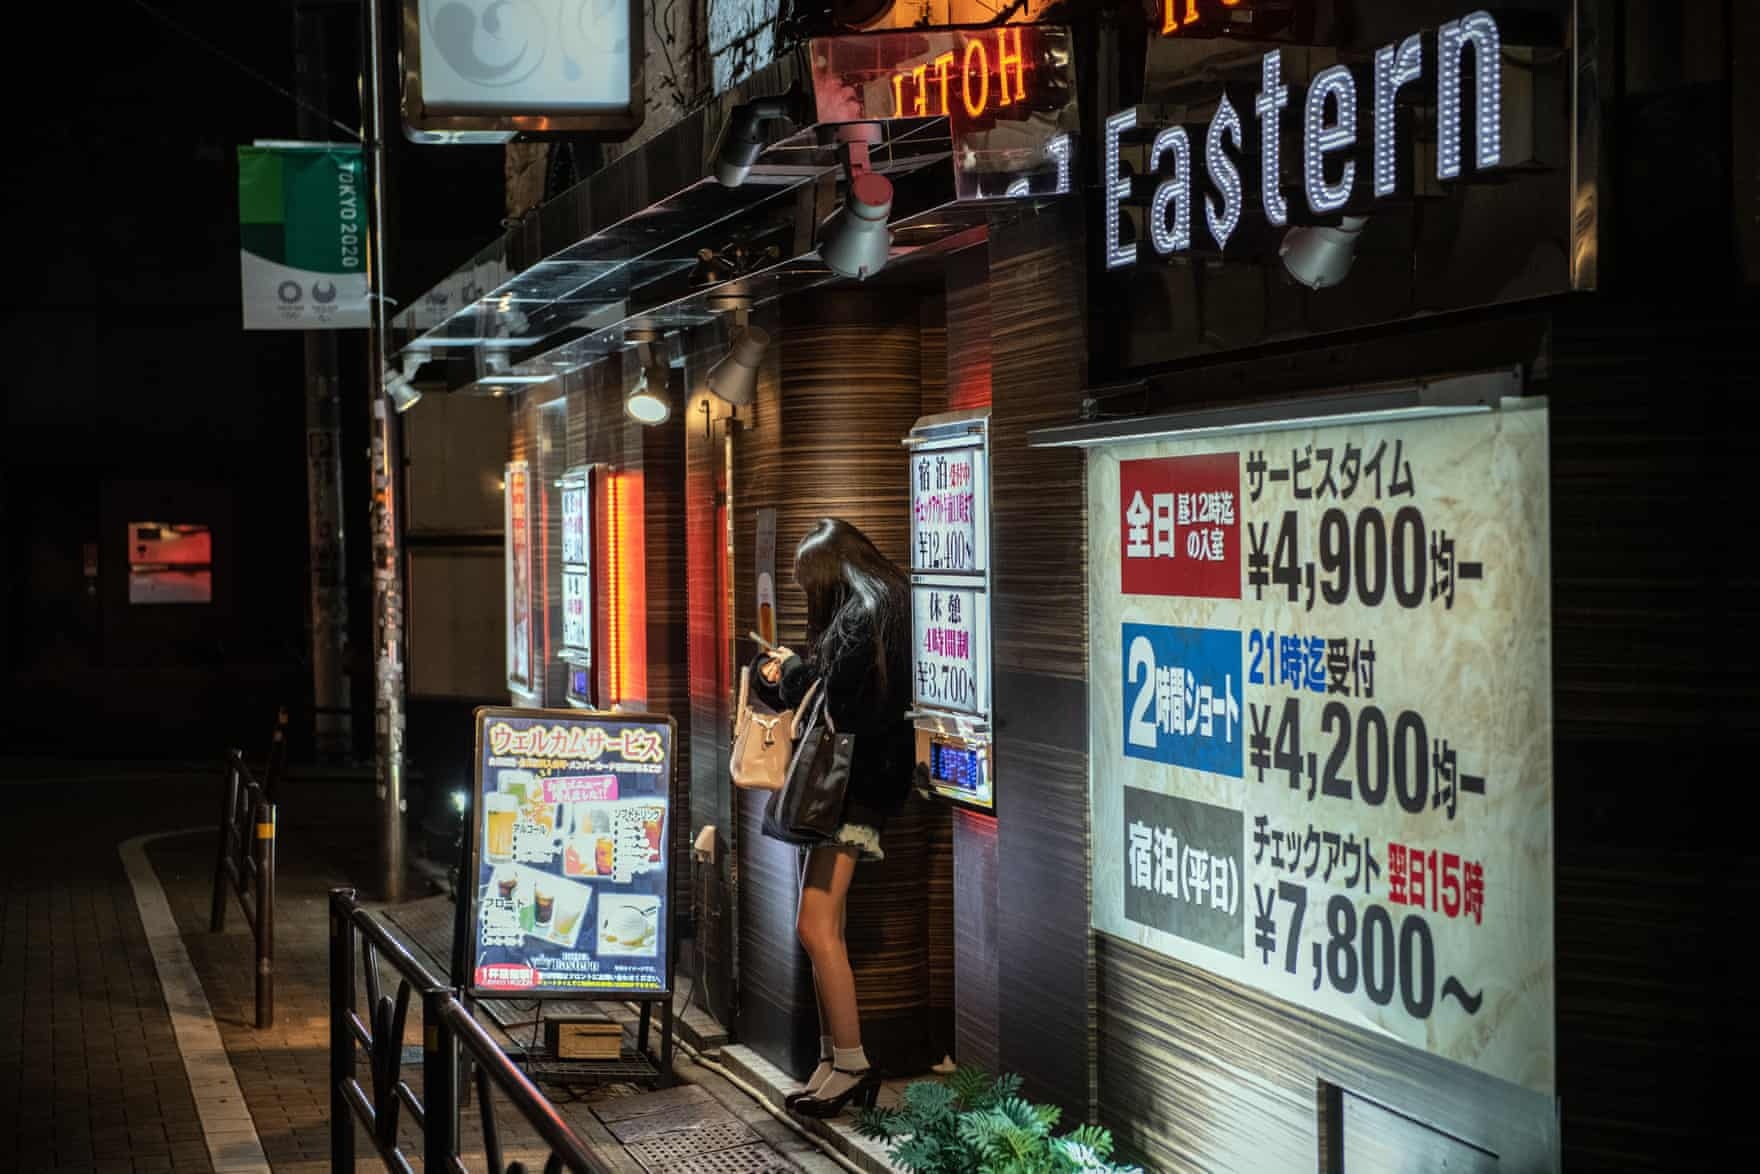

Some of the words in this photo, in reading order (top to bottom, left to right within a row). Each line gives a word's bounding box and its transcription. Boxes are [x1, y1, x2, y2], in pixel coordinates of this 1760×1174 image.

[1106, 9, 1501, 270] Eastern
[338, 161, 357, 220] TOKYO
[341, 225, 359, 268] 2020
[918, 456, 948, 491] 宿泊
[1246, 439, 1415, 503] サービスタイム
[1126, 490, 1175, 558] 全日
[1187, 528, 1224, 560] の入室
[929, 591, 961, 624] 休憩
[923, 627, 969, 660] 4時間制
[1127, 635, 1239, 748] 2時間ショート
[490, 723, 664, 762] ウェルカムサービス
[1253, 815, 1381, 894] チェックアウト
[1387, 842, 1485, 926] 翌日15時
